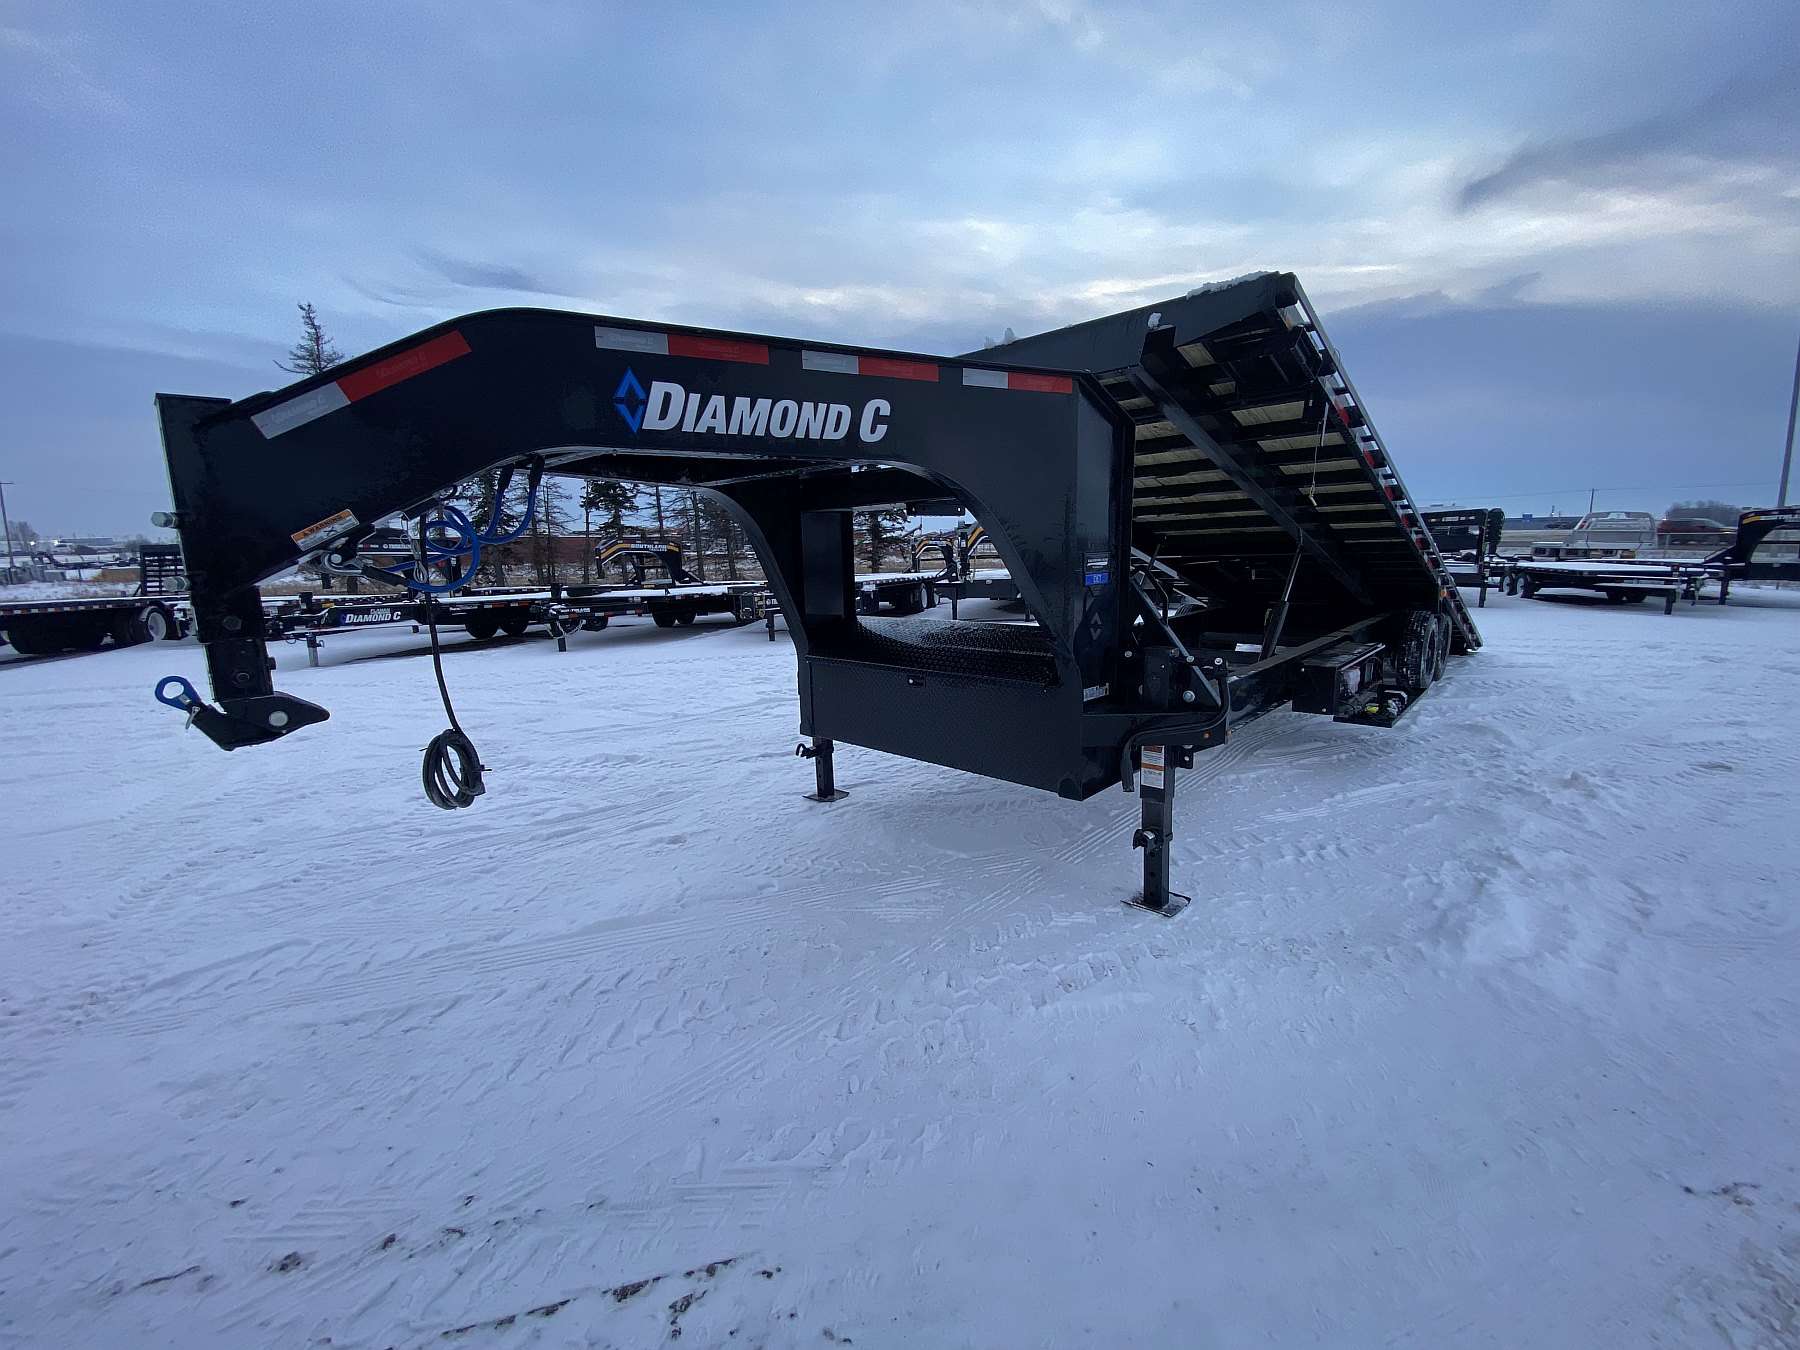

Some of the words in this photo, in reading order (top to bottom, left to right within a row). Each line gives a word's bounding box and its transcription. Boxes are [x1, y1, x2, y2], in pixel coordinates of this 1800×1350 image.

[642, 381, 851, 440] DIAMOND
[859, 398, 891, 443] C
[345, 613, 391, 623] DIAMOND
[393, 611, 401, 620] C
